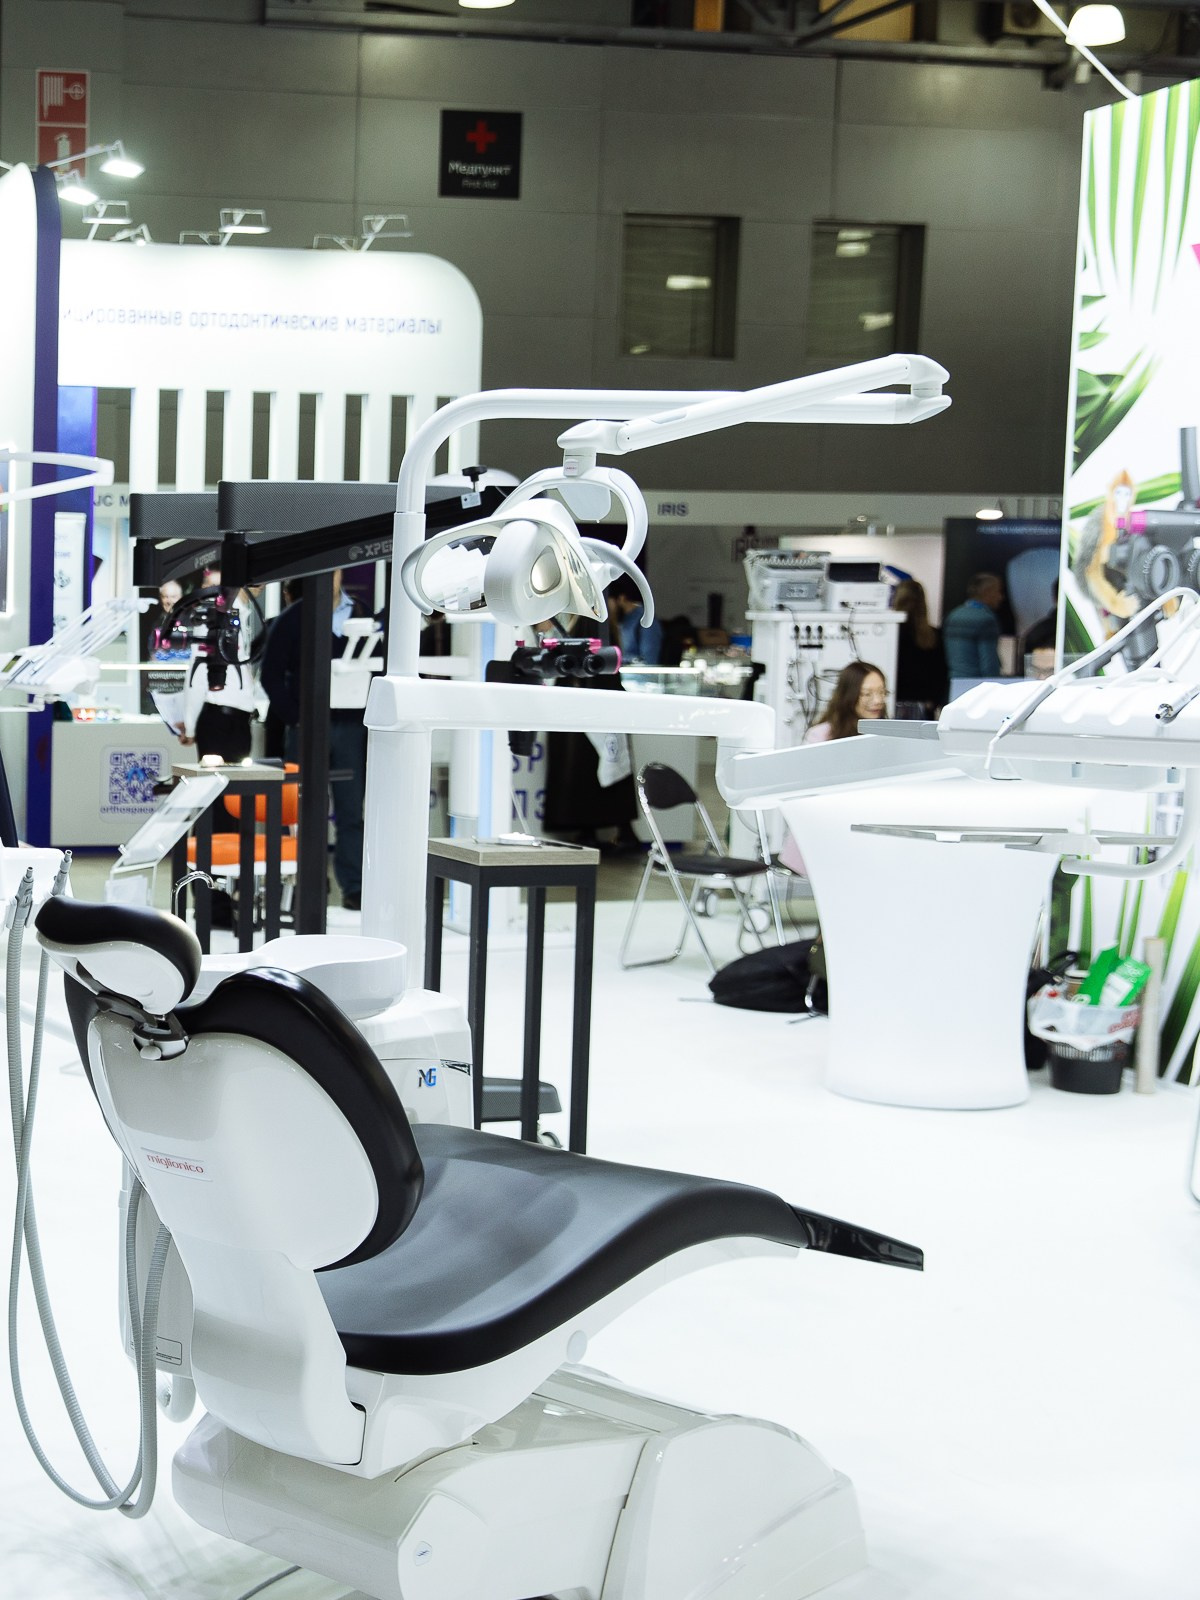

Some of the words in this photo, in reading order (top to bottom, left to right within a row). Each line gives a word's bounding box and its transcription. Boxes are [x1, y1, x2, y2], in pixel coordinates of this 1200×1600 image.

[448, 160, 511, 177] Медпункт
[189, 311, 339, 331] ортодонтические
[345, 315, 442, 334] материалы
[657, 502, 688, 516] IRIS
[364, 539, 393, 557] XPE
[146, 1154, 204, 1174] miglionico
